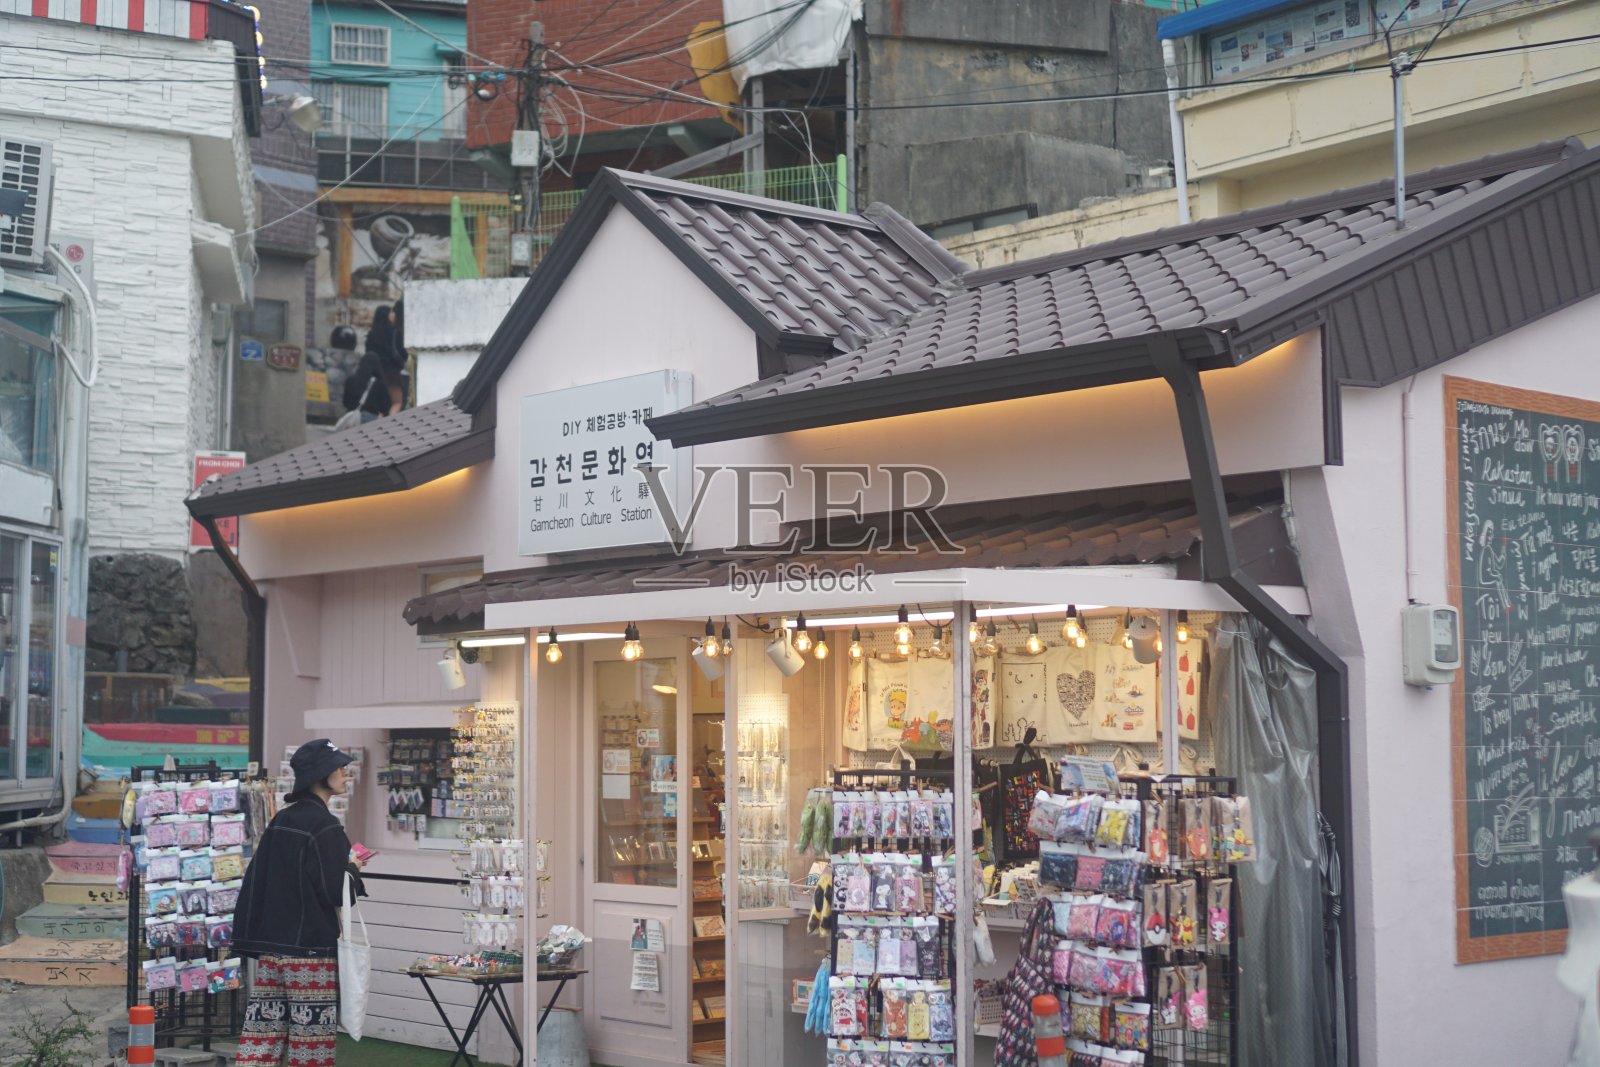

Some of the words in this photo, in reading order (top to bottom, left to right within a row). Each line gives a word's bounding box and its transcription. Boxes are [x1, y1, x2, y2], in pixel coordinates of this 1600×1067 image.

[562, 419, 581, 437] DIY
[529, 440, 653, 488] 감천문화역
[530, 516, 574, 532] Gamcheon
[580, 511, 612, 527] Culture
[620, 506, 652, 522] Station
